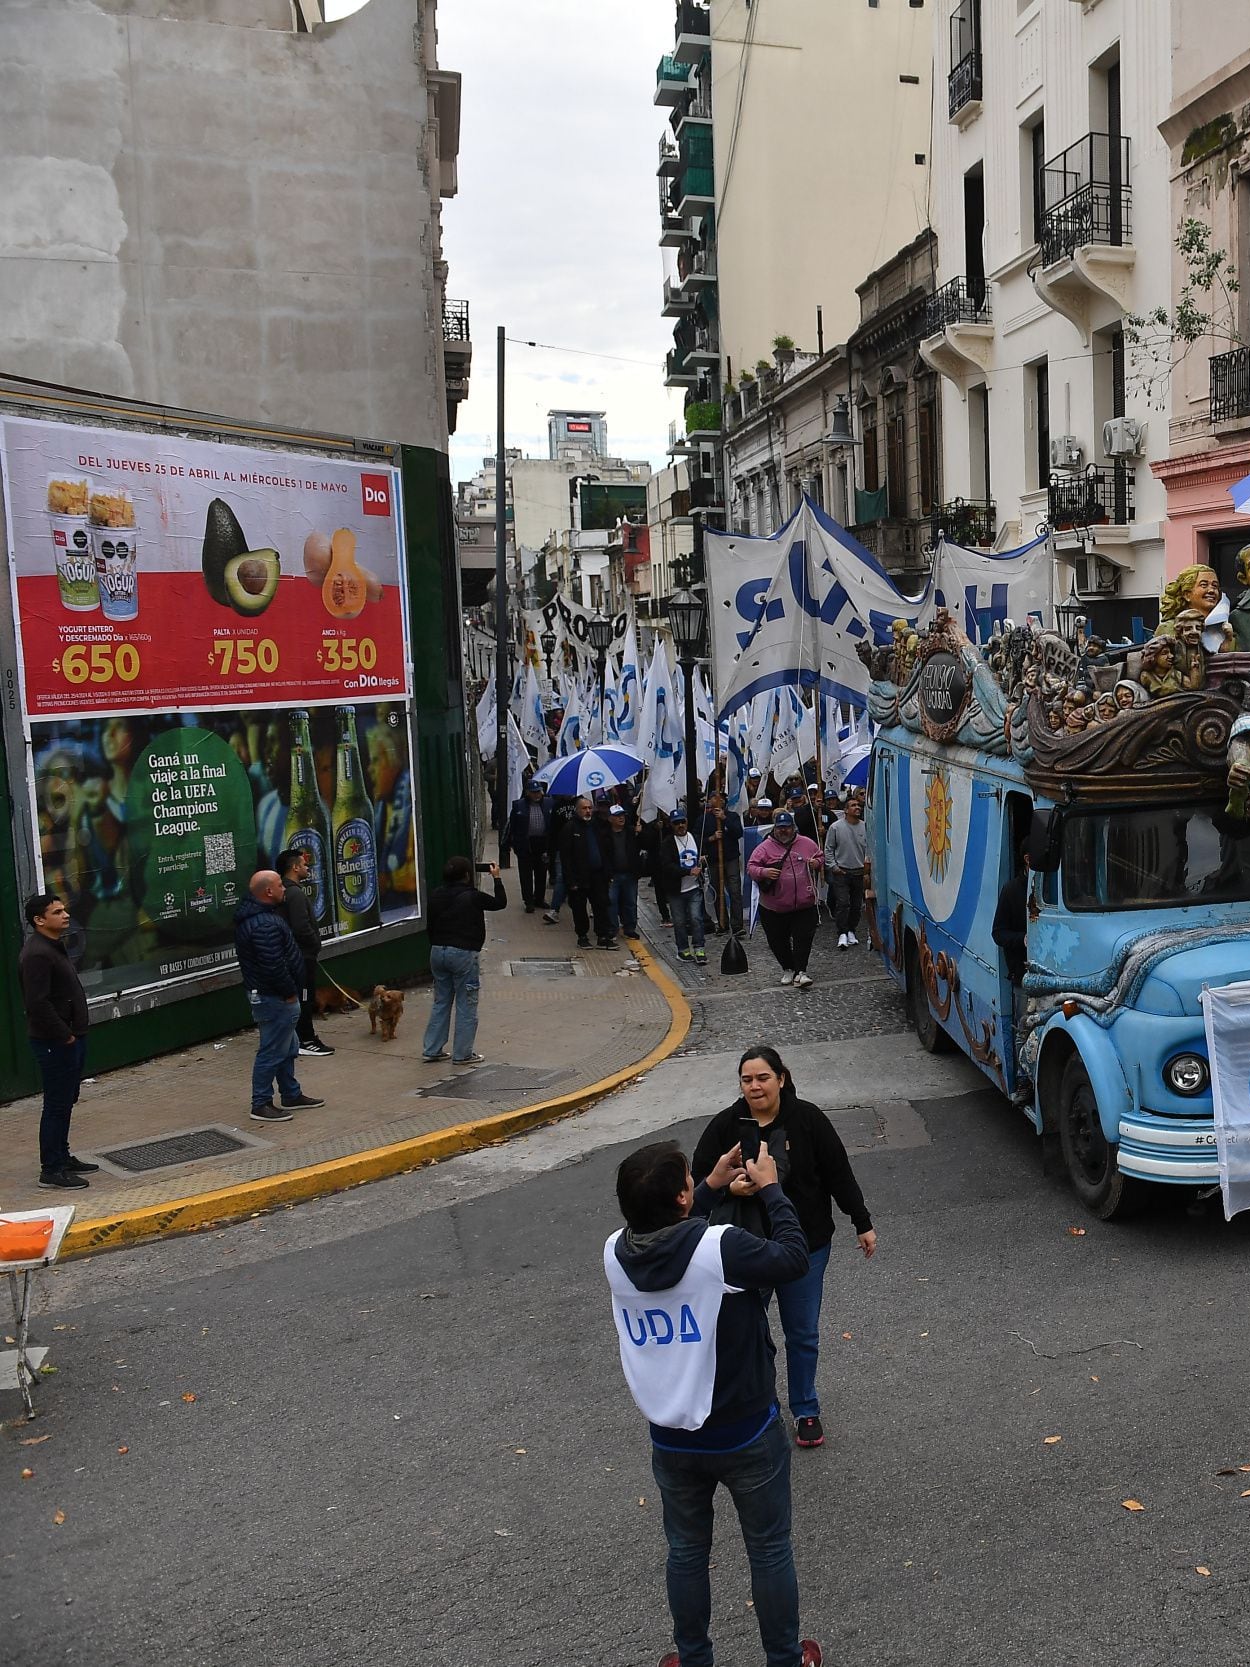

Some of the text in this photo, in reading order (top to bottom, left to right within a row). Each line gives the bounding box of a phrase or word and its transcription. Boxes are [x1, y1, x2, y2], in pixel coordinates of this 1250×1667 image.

[78, 455, 348, 493] DEL JUEVES 25 DE ABRIL AL MIÉRCOLES 1 DE MAYO
[59, 562, 95, 583] YOGUR
[100, 573, 134, 595] YOGUR
[58, 625, 114, 633] YOGURT ENTERO
[66, 634, 112, 642] DESCREMADO
[213, 628, 231, 636] PALTA
[52, 643, 140, 684] $650
[207, 638, 279, 675] $750
[316, 637, 377, 672] $350
[6, 669, 16, 710] 0025
[343, 679, 359, 688] Con
[378, 676, 400, 688] llegás
[148, 752, 199, 768] Ganá un
[150, 763, 227, 785] viaje a la final
[152, 783, 216, 803] de la UEFA
[153, 801, 218, 819] Champions
[155, 820, 201, 836] League.
[160, 964, 168, 975] VER
[169, 960, 183, 973] BASES
[622, 1303, 702, 1347] UDA
